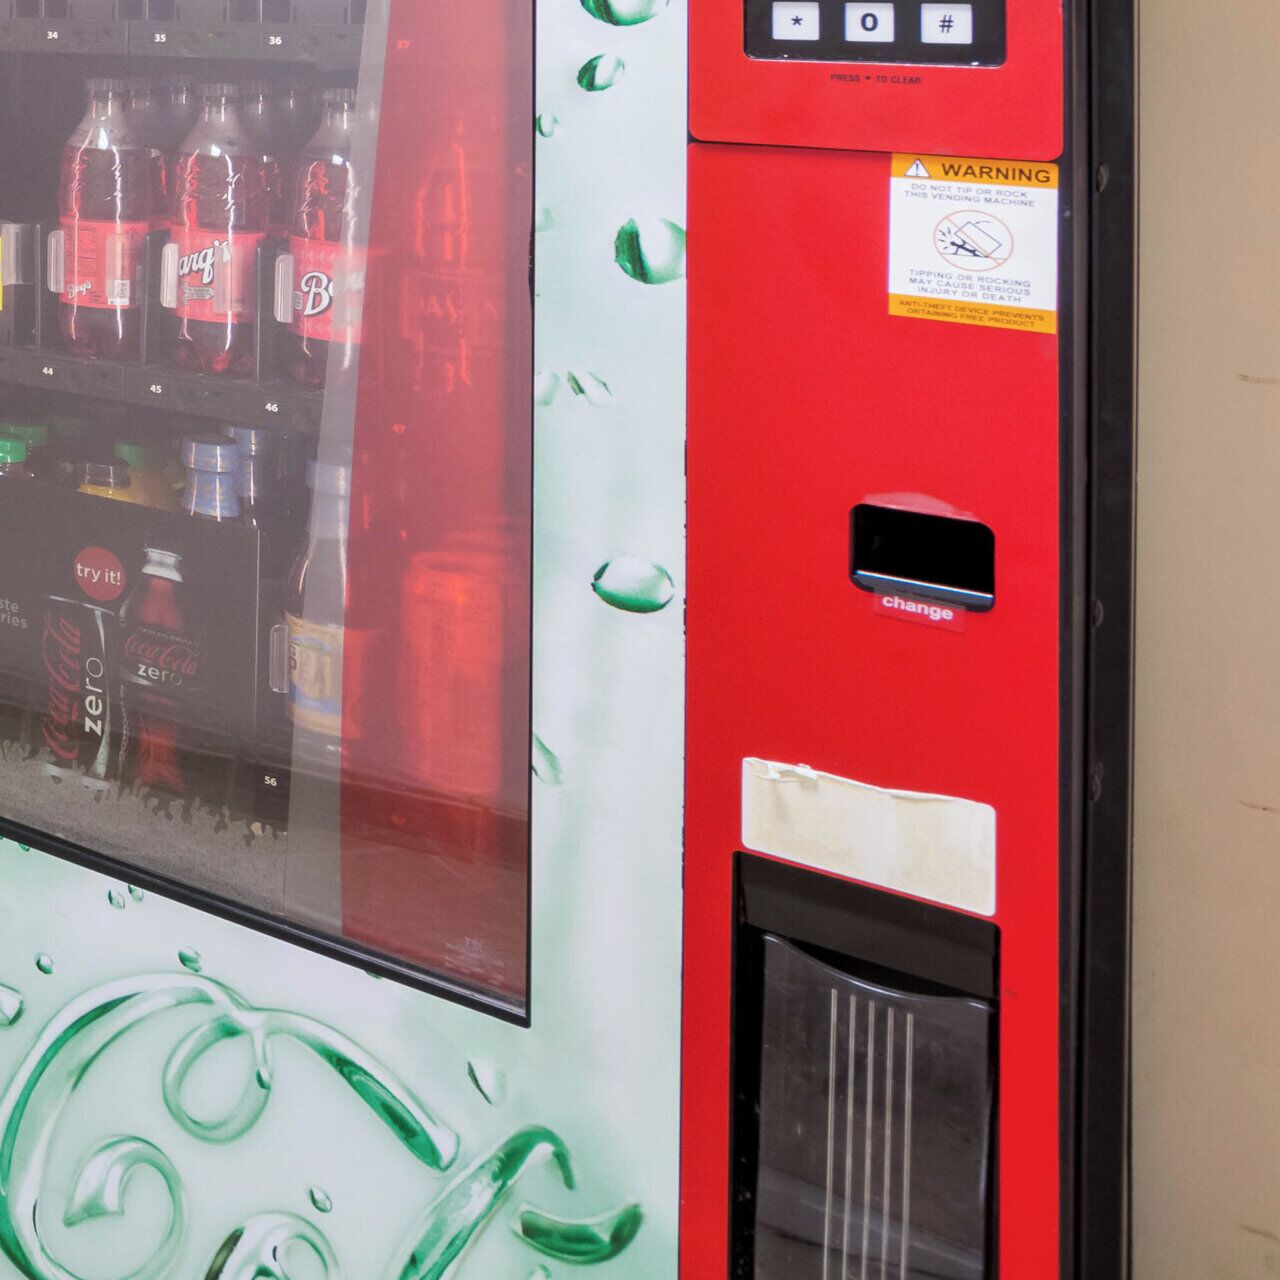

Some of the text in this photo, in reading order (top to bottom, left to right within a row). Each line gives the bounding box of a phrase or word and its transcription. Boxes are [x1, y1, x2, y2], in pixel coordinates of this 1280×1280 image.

[860, 12, 954, 34] 0 #
[47, 30, 58, 40] 34
[154, 33, 166, 43] 35
[269, 35, 282, 45] 36
[829, 73, 923, 86] PRESS TO CLEAR
[940, 162, 1051, 184] WARNING
[904, 190, 1037, 208] THIS VENDING MACHINE
[911, 182, 1028, 199] DO NOT TIP OR ROCK
[908, 277, 1032, 297] MAY CAUSE SERIOUS
[909, 269, 1032, 288] TIPPING OR ROCKING
[917, 286, 1022, 304] INJURY OR DEATH
[899, 299, 1046, 322] ANTI-THEFT DEVICE PREVENTS
[906, 307, 1037, 329] OBTAINING FREE PRODUCT
[42, 366, 54, 376] 44
[149, 384, 162, 394] 45
[265, 402, 279, 413] 46
[76, 561, 122, 587] try it!
[882, 595, 955, 621] change
[124, 632, 200, 676] Coca-Cola
[137, 662, 184, 688] zero
[84, 656, 105, 738] zero
[264, 775, 278, 787] 56
